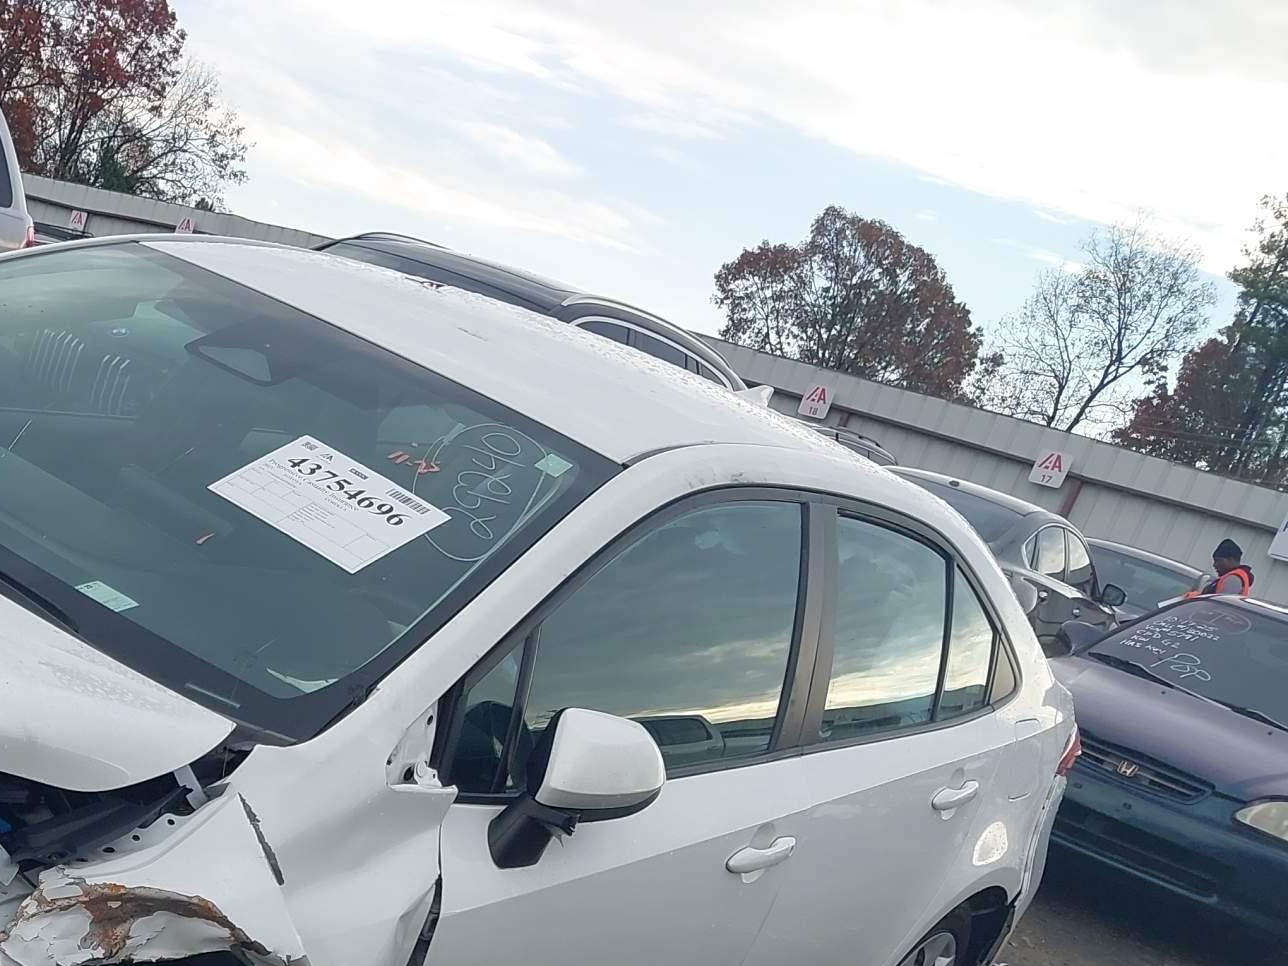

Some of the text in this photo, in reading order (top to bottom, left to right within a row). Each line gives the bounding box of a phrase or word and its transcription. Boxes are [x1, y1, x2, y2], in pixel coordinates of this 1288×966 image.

[287, 457, 412, 526] 43754696
[441, 432, 527, 540] 29240
[1041, 474, 1053, 484] 17
